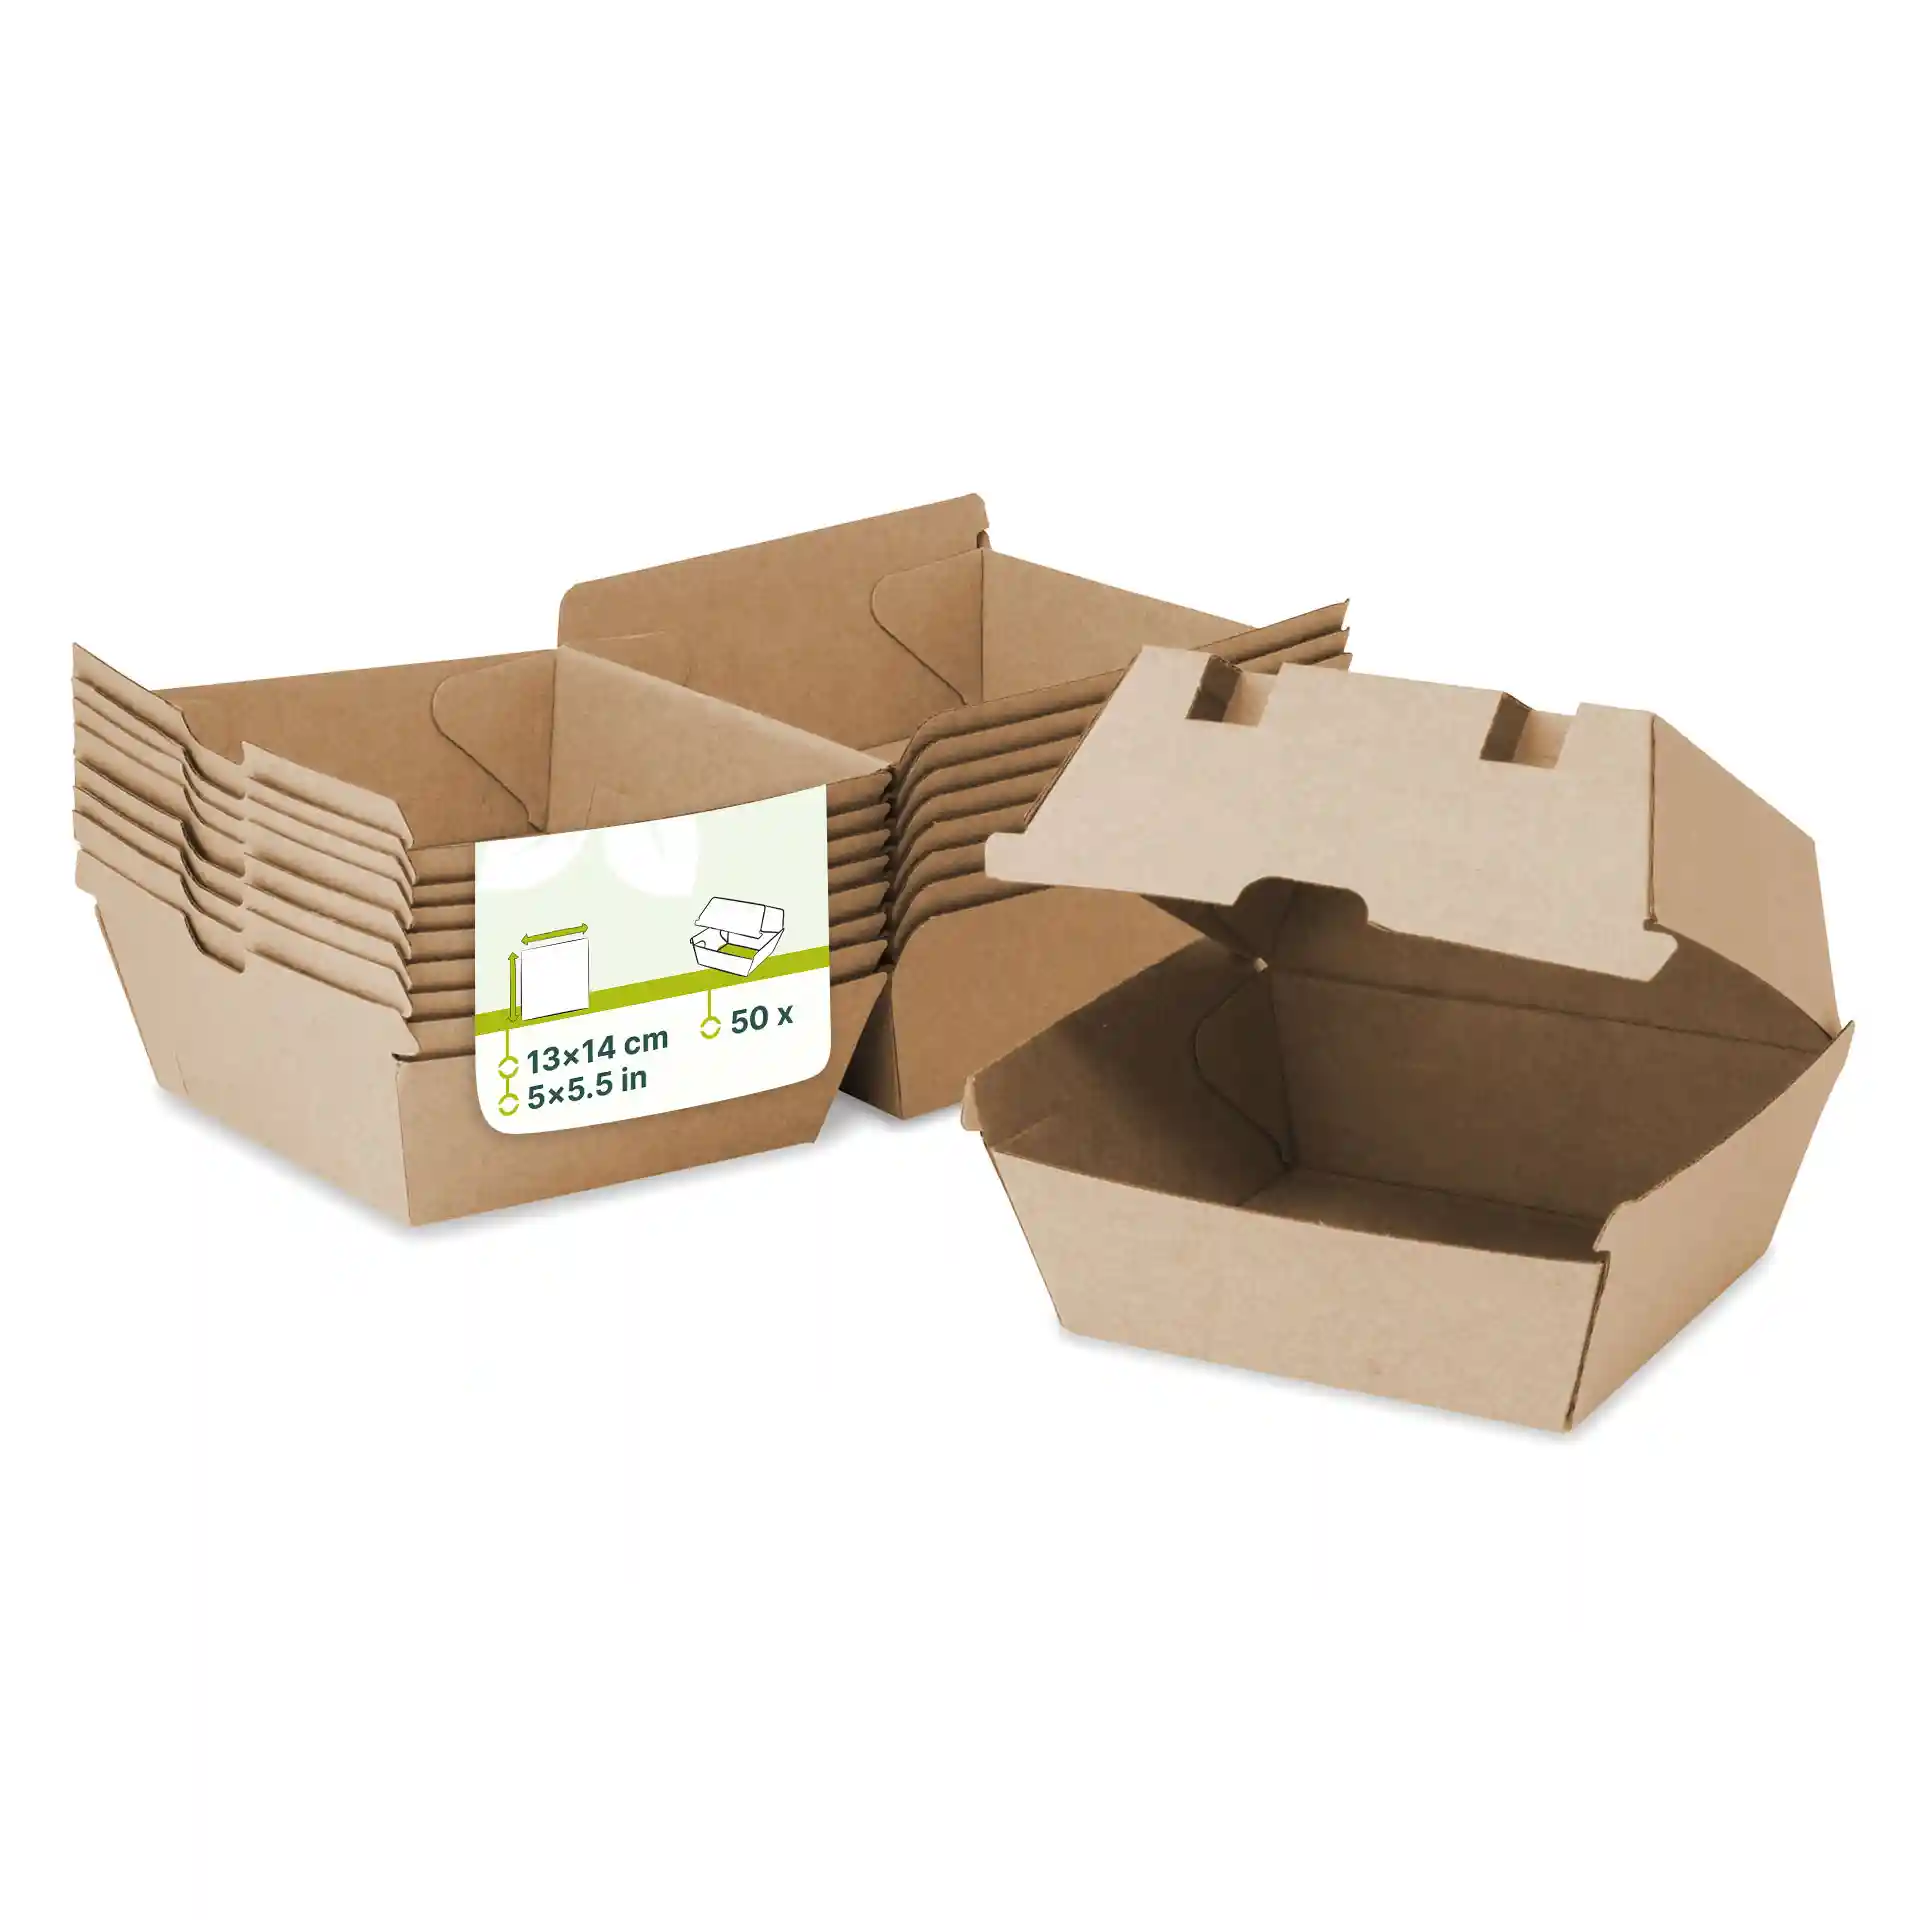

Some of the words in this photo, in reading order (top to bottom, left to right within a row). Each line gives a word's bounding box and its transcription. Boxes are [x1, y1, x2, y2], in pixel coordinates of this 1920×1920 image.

[731, 1005, 769, 1034] 50
[624, 1030, 668, 1055] cm
[621, 1067, 647, 1092] in
